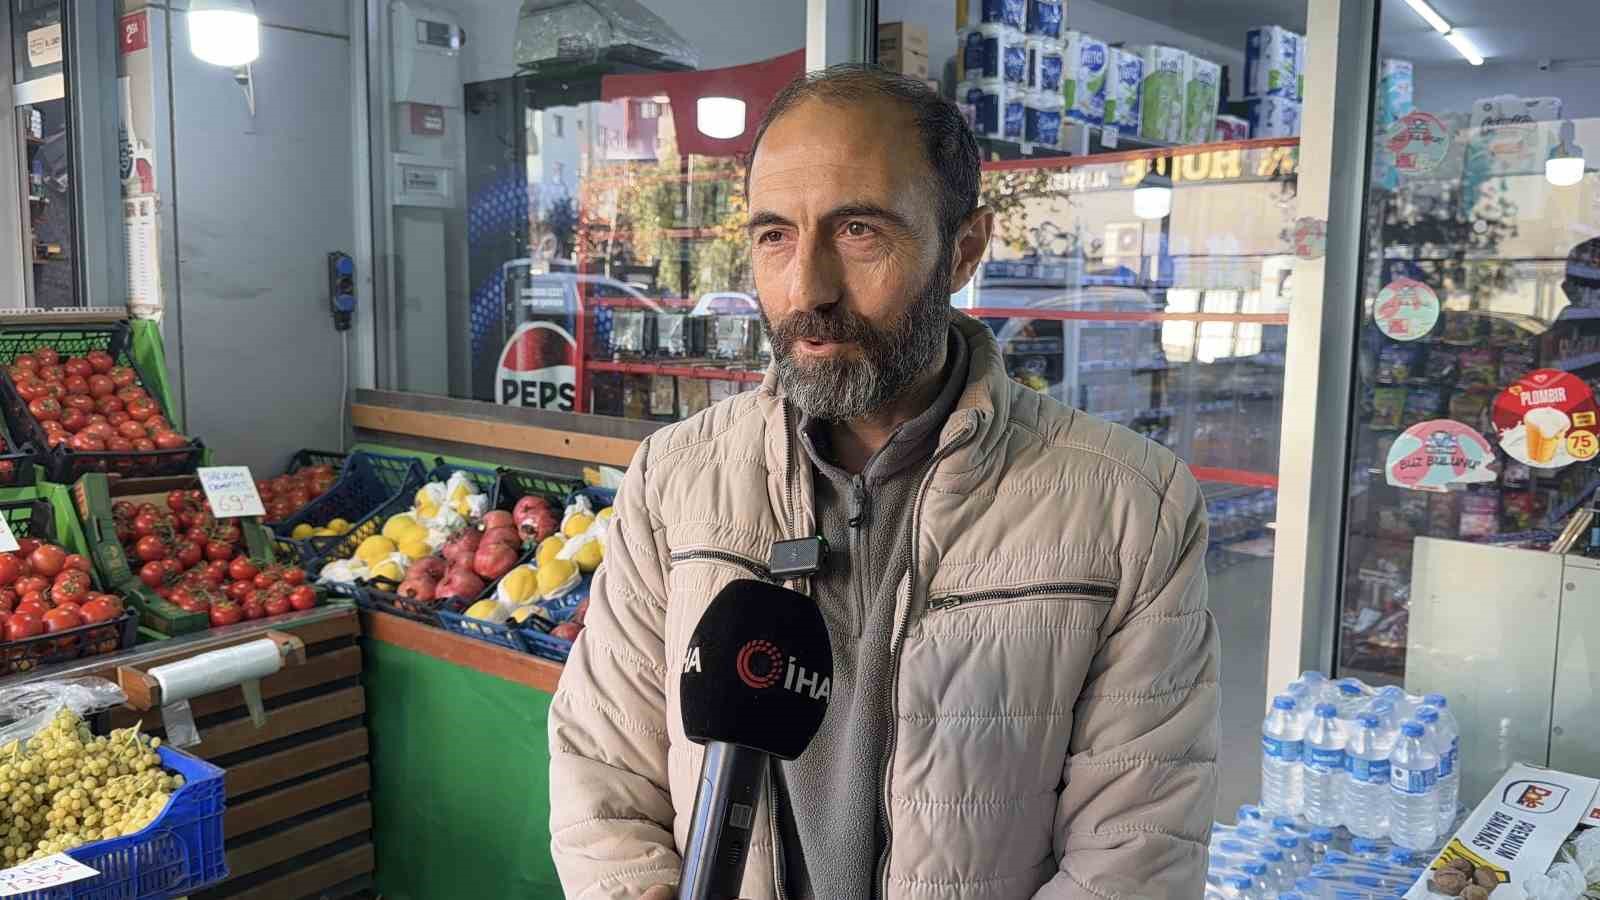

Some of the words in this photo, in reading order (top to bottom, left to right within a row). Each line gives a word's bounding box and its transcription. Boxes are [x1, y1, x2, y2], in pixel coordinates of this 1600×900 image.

[1520, 387, 1567, 407] PLOMBIR
[1570, 434, 1592, 449] 75
[783, 655, 832, 704] İHA
[1471, 811, 1514, 850] BANANAS
[1495, 820, 1536, 861] PREMIUM
